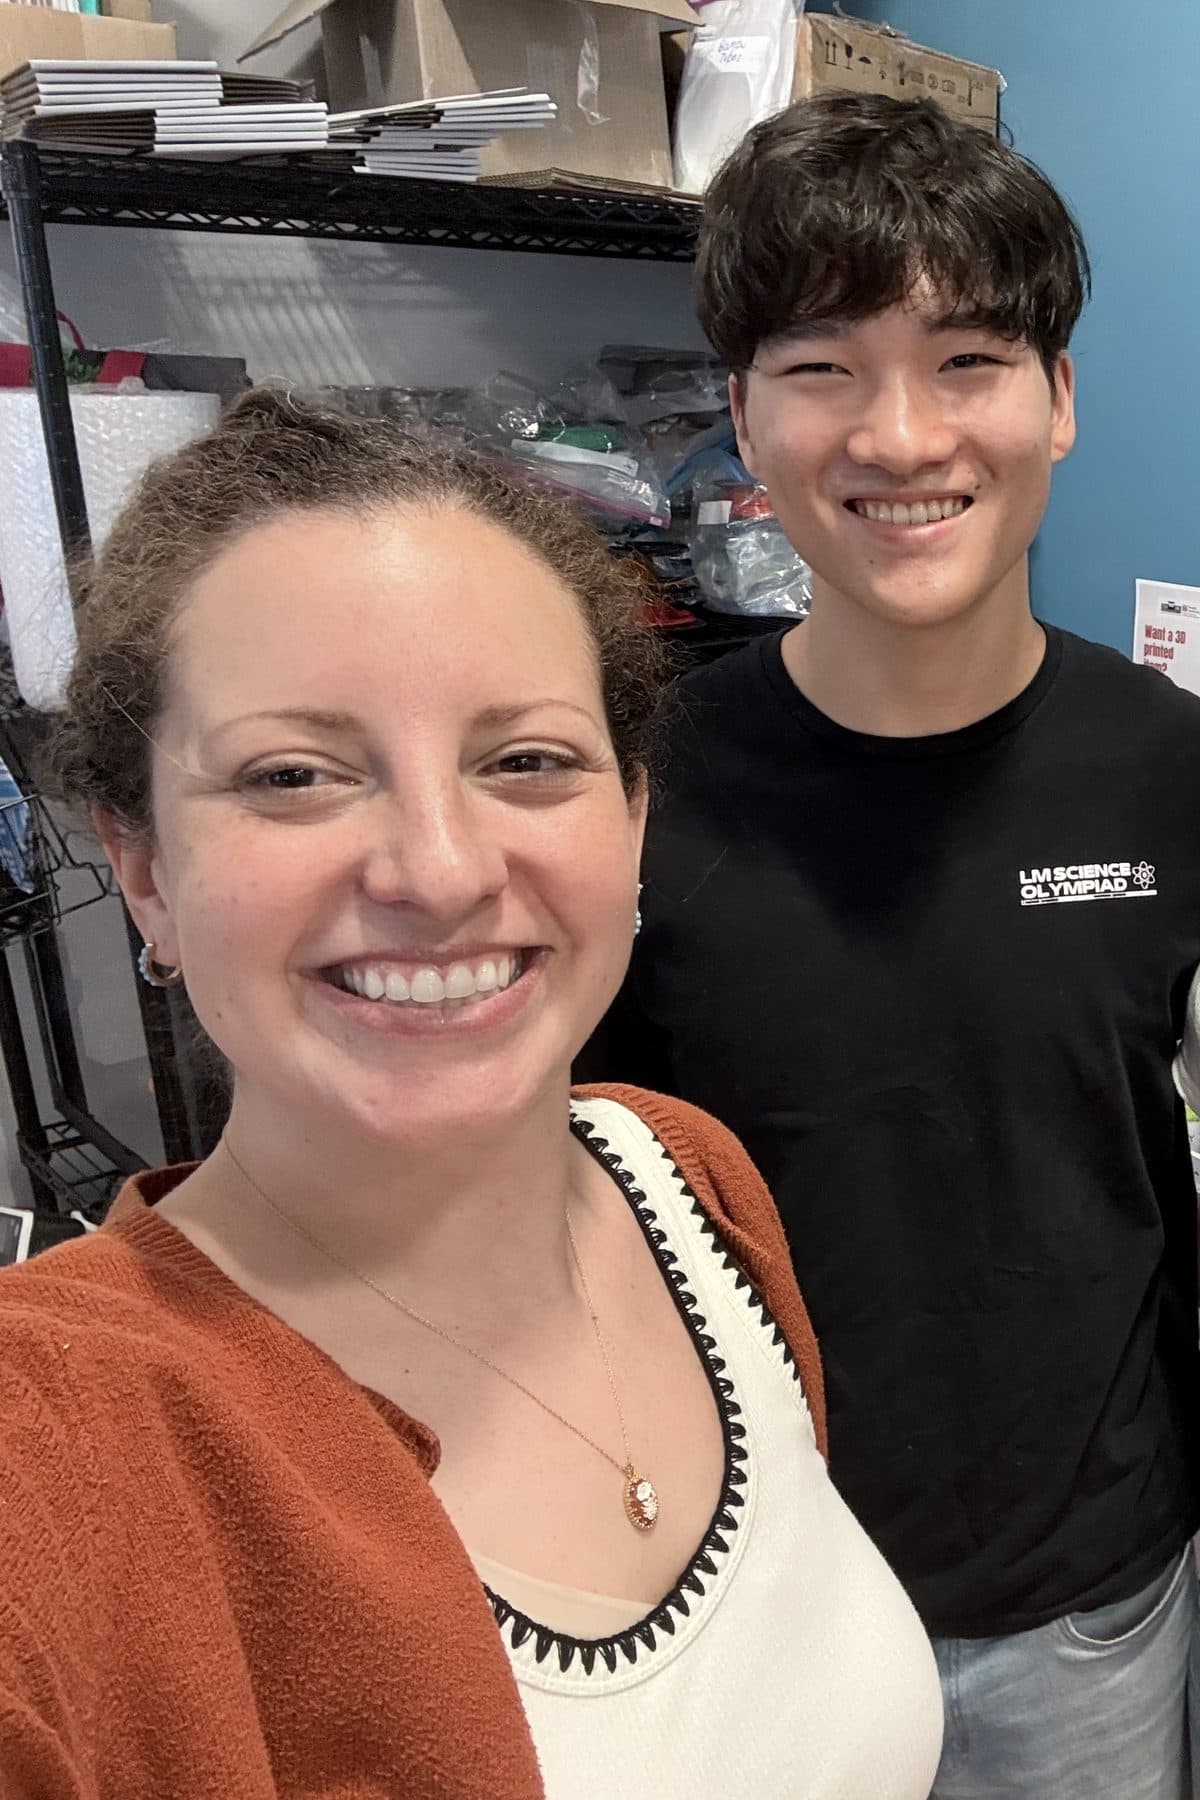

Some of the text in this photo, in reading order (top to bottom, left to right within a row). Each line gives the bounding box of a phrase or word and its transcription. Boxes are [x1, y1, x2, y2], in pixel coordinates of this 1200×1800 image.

[1145, 624, 1186, 644] Want a 3D
[1144, 643, 1174, 659] printed
[1020, 862, 1131, 884] LM SCIENCE
[1020, 878, 1127, 899] OLYMPIAD
